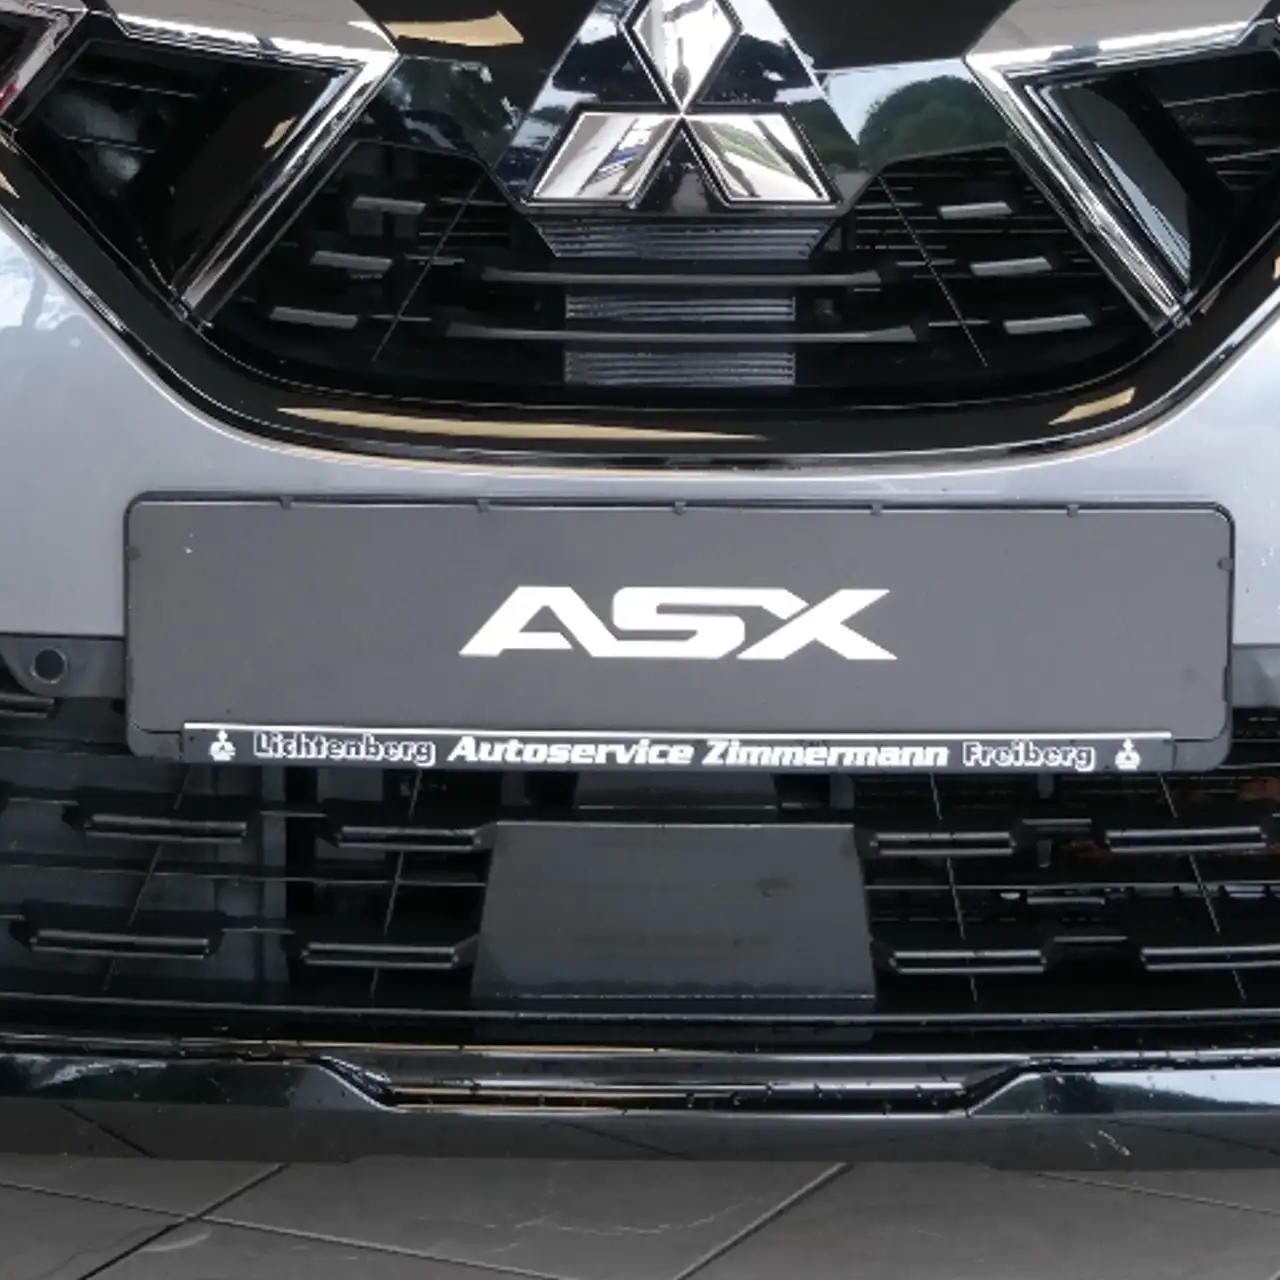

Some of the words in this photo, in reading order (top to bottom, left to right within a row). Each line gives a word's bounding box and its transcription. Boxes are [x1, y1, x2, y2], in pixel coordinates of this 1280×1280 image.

[459, 586, 898, 660] ASX
[253, 730, 437, 768] Lichtenberg
[447, 735, 694, 767] Autoservice
[701, 738, 950, 768] Zimmermann
[962, 740, 1098, 771] Freiberg
